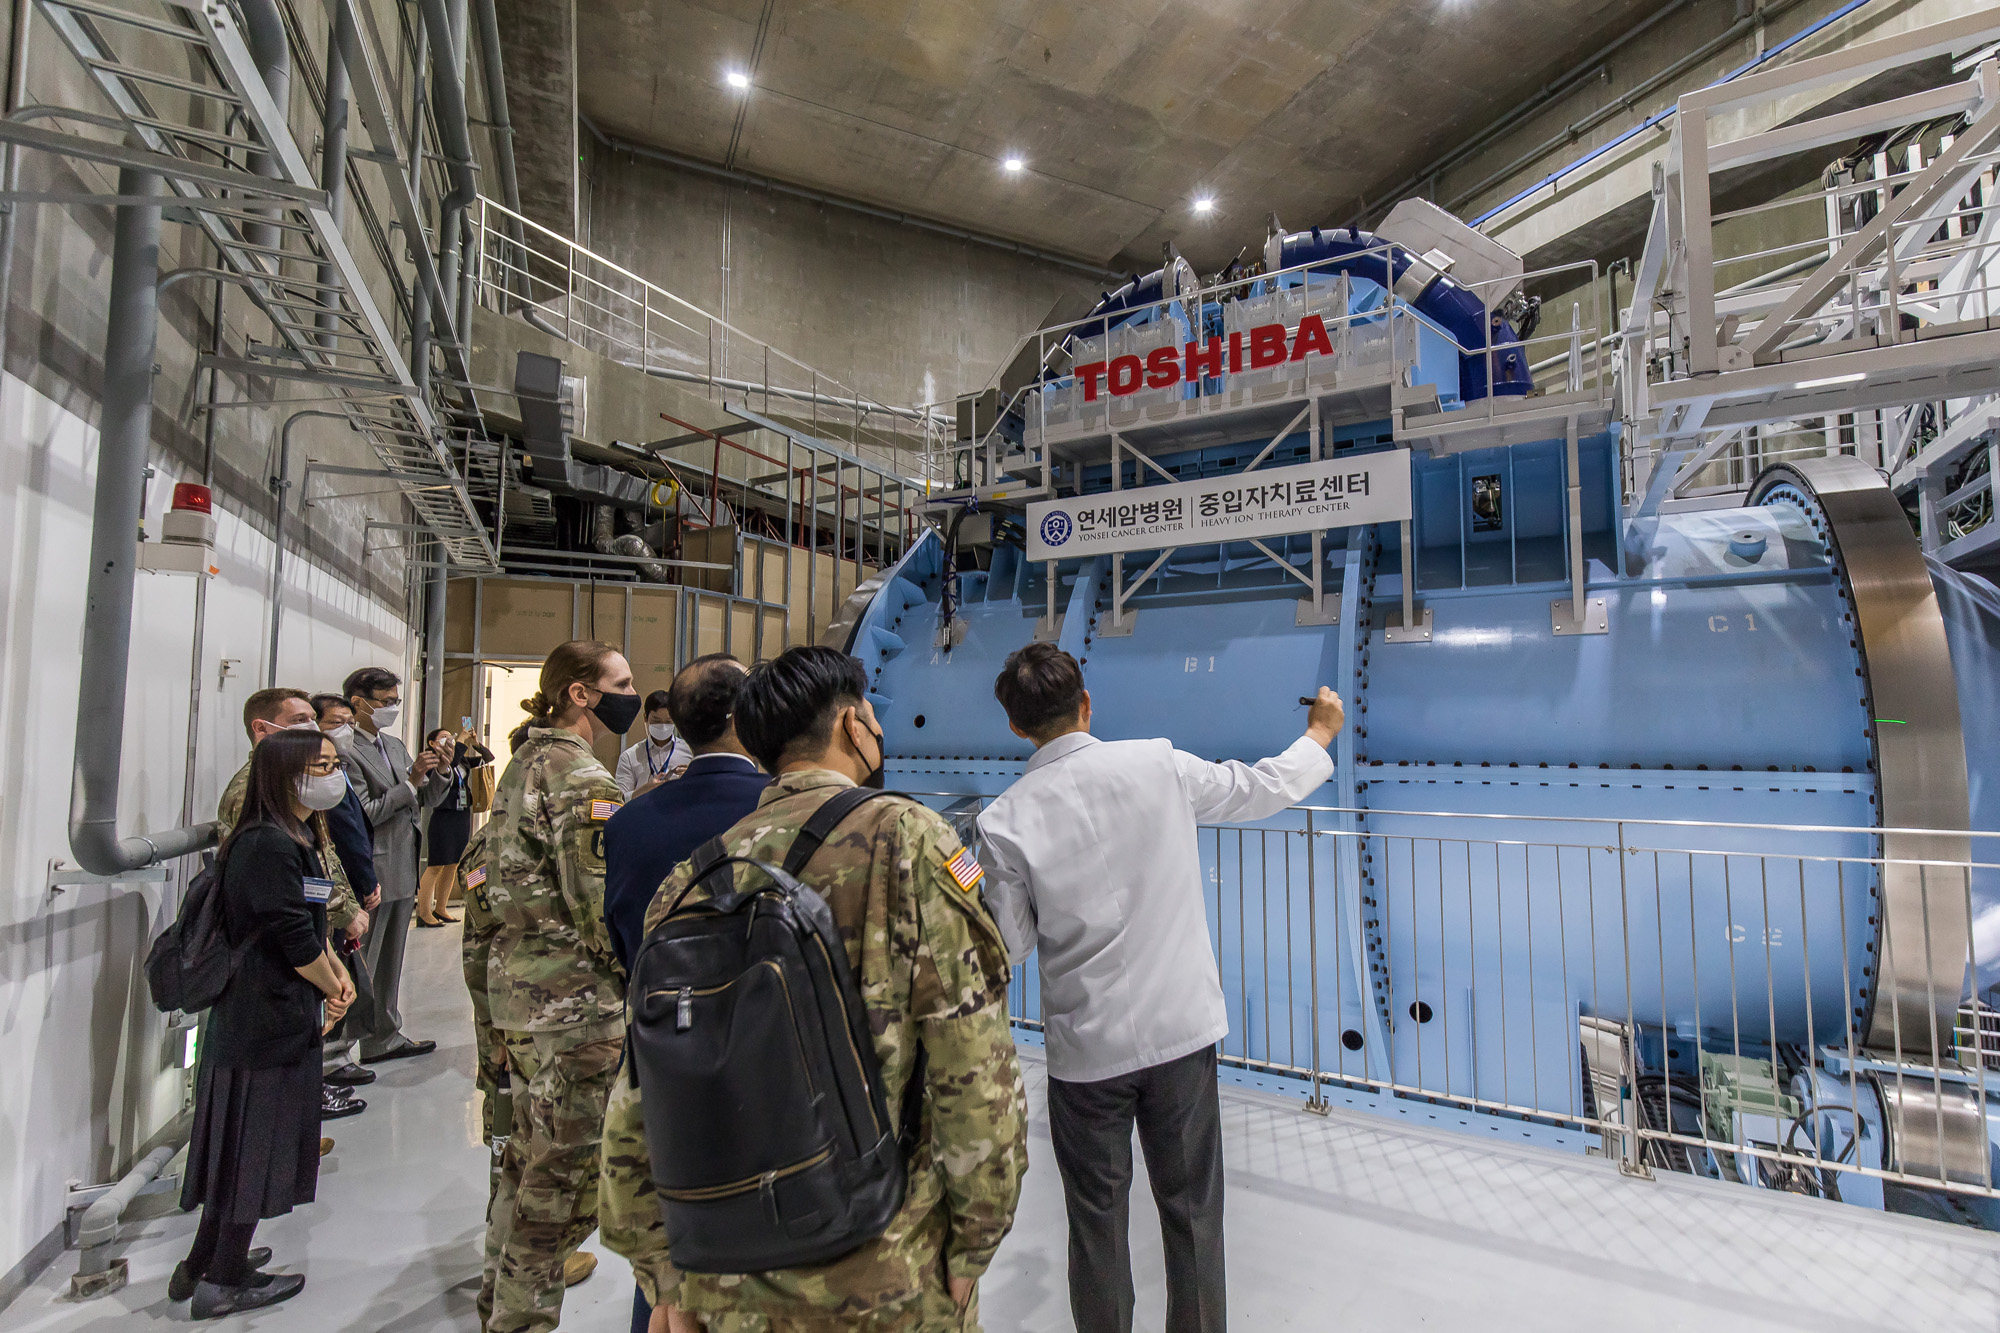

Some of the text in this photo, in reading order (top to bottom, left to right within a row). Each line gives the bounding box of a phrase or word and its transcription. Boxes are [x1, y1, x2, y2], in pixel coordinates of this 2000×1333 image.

[1074, 313, 1335, 402] TOSHIBA
[1077, 471, 1370, 531] 연세암병원 중입자치료센터
[1201, 501, 1351, 528] HEAVY ION THERAPY CENTER
[1078, 531, 1109, 542] YONSEI
[1111, 527, 1147, 538] CANCER
[1148, 522, 1184, 534] CENTER
